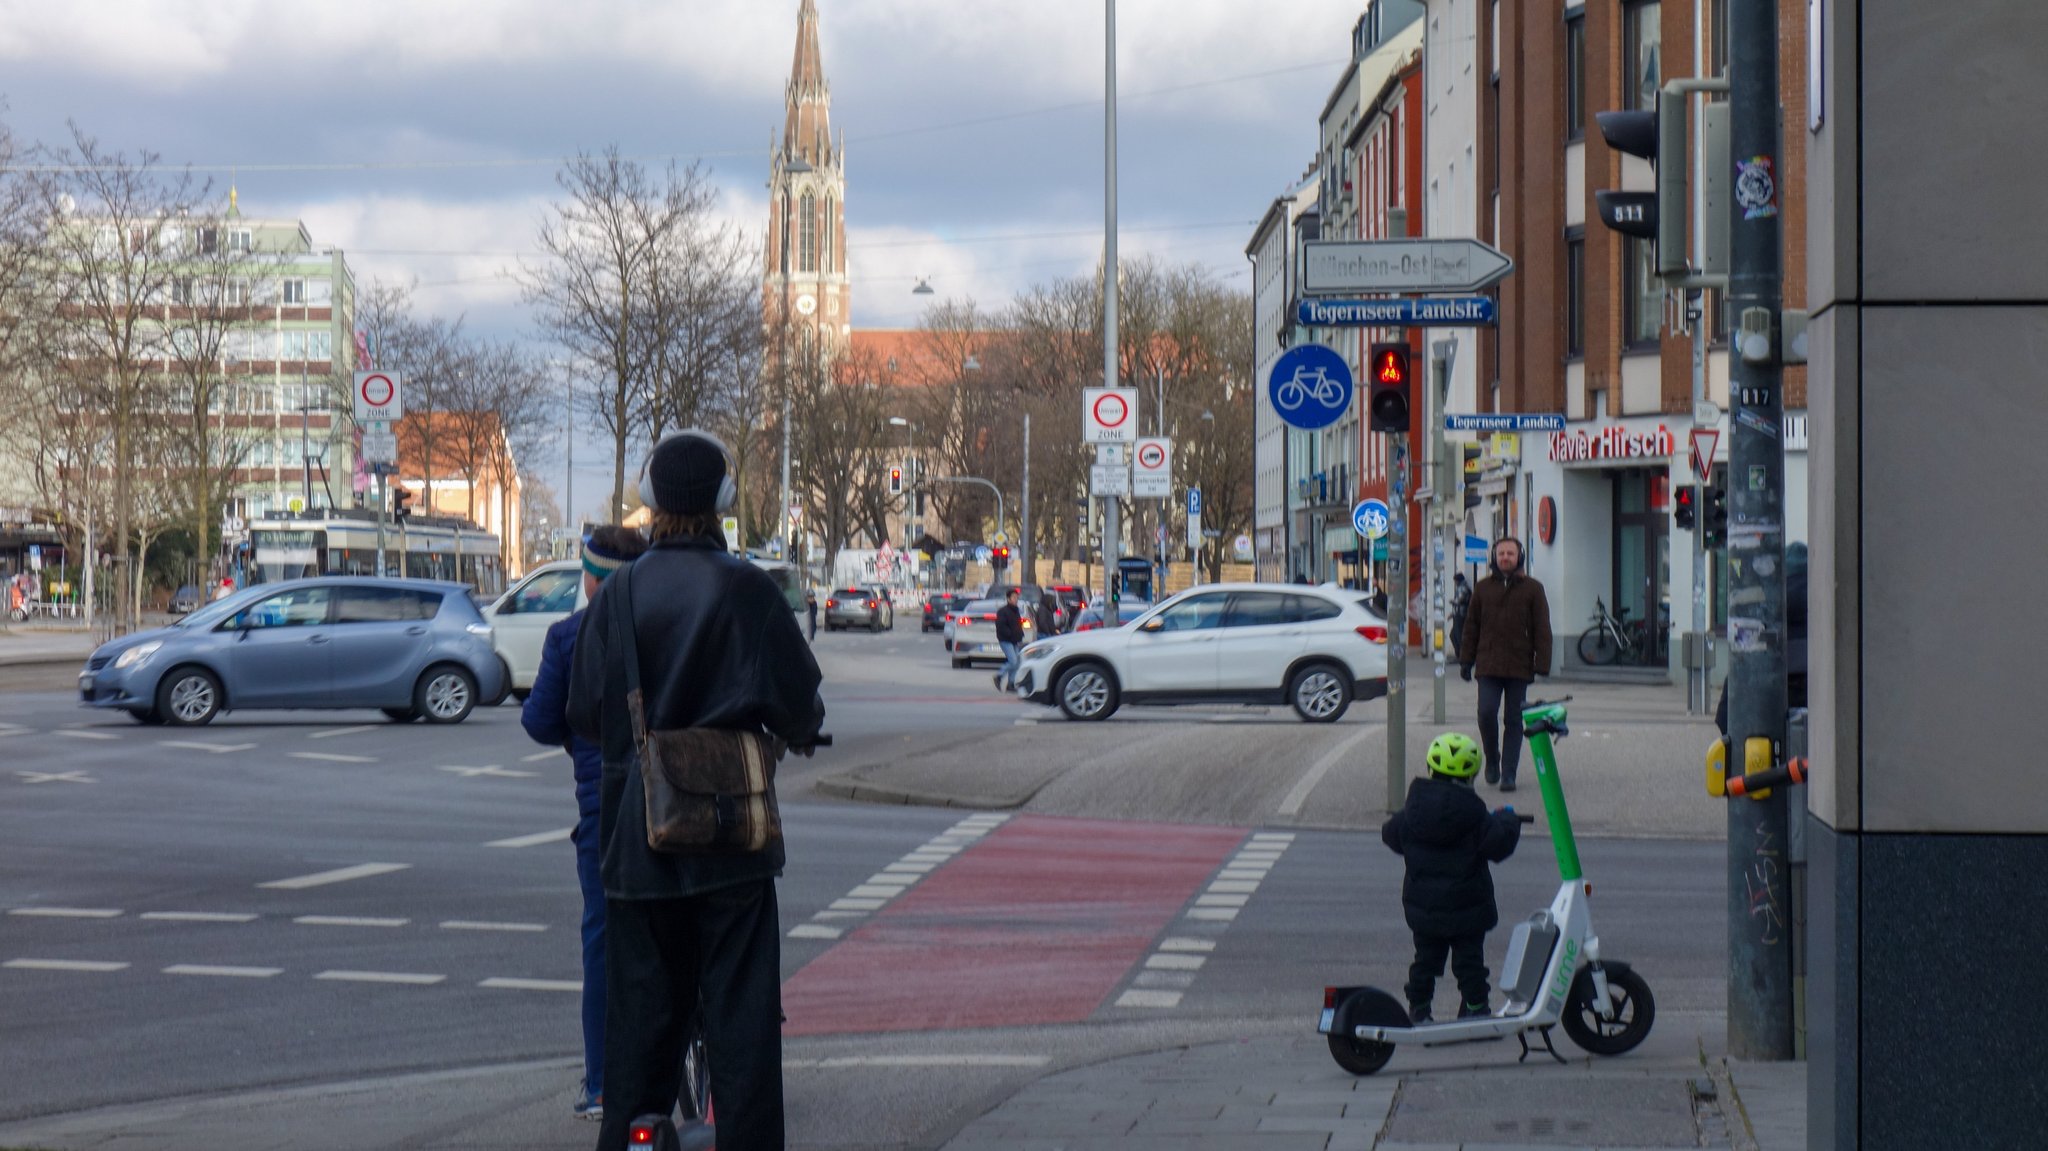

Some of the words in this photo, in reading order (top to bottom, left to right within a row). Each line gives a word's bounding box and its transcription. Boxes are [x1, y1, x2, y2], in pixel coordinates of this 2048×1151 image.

[1311, 253, 1429, 278] München-Ost
[1307, 300, 1403, 324] Tegernseer
[1411, 299, 1483, 320] Landstr.
[366, 407, 391, 417] ZONE
[1452, 415, 1513, 429] Tegernseer
[1516, 415, 1560, 429] Landstr.
[1097, 430, 1124, 439] ZONE
[1547, 430, 1594, 462] Klavier
[1600, 425, 1672, 459] Hirsch
[1551, 937, 1578, 998] Lime
